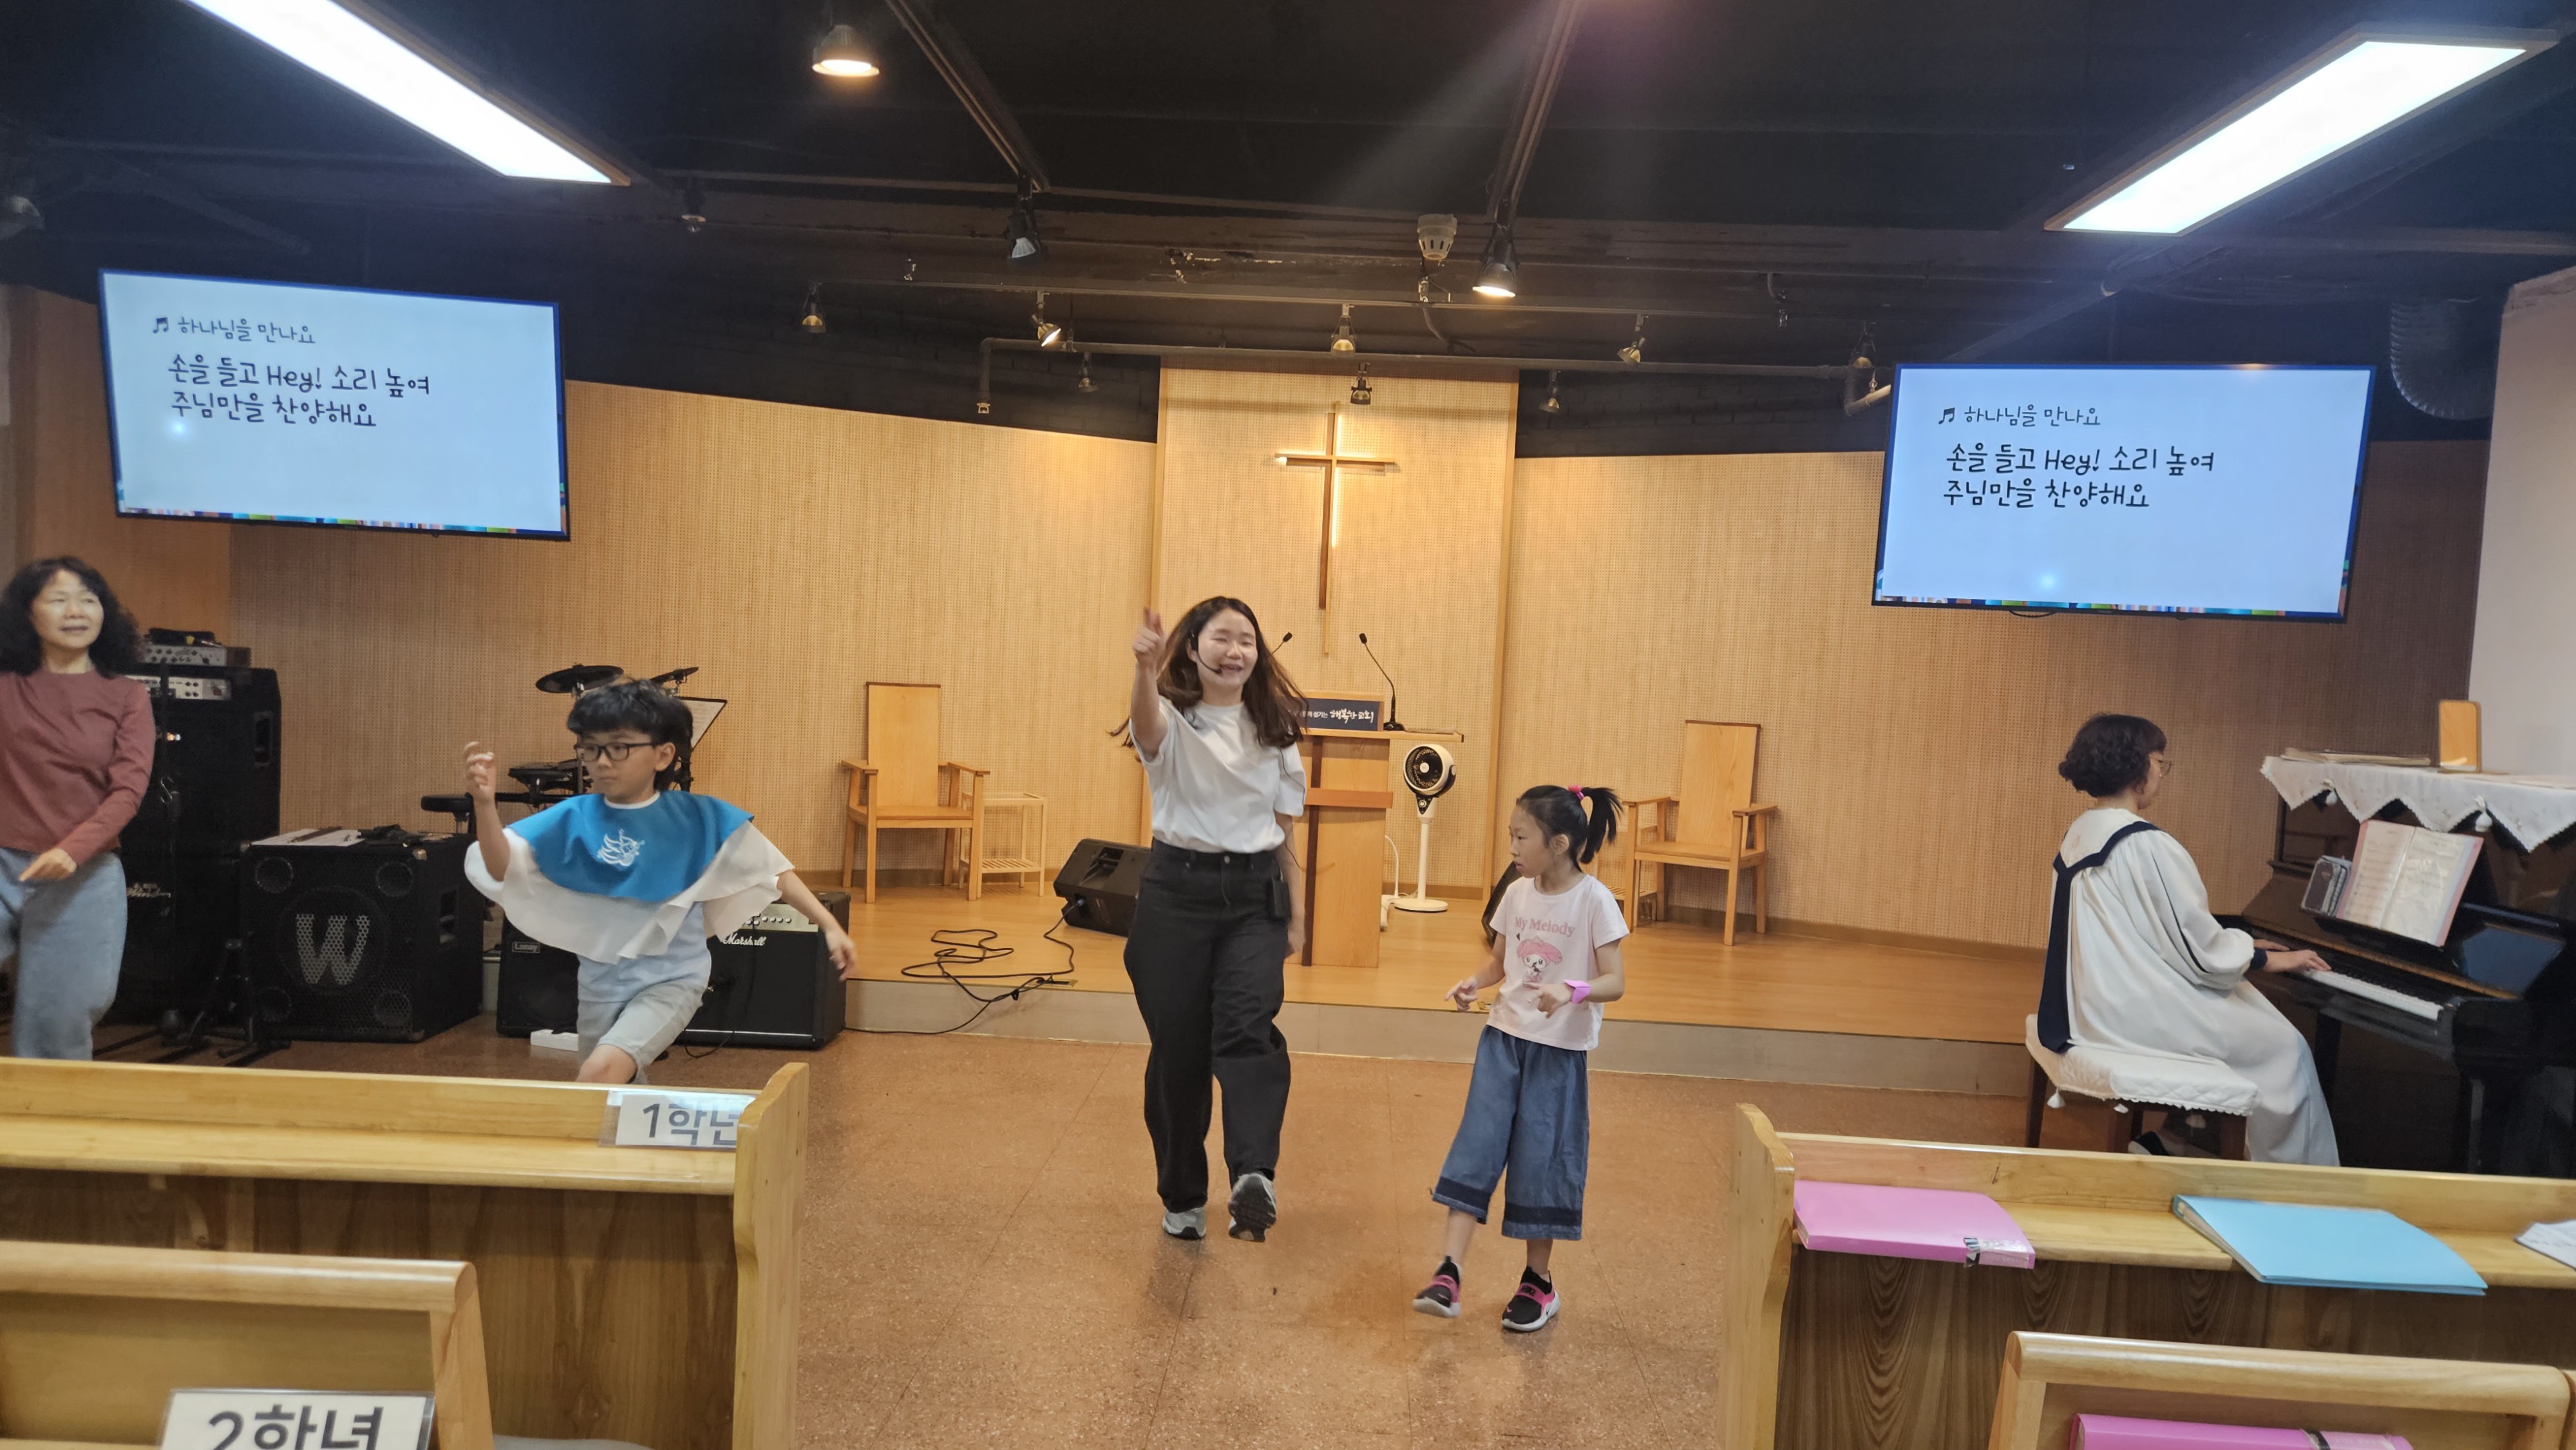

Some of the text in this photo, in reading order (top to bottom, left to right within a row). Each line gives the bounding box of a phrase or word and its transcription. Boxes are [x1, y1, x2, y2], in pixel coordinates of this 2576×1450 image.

[177, 316, 316, 344] 하나님을 만나요
[168, 353, 430, 399] 손을 들고 Hey! 소리 높여
[171, 391, 377, 427] 주님만을 찬양해요
[1964, 404, 2101, 428] 하나님을 만나요
[1946, 442, 2215, 476] 손을 들고 Hey! 소리 높여
[1943, 478, 2150, 509] 주님만을 찬양해요
[1329, 708, 1358, 724] 행복한
[1358, 710, 1374, 723] 교회
[1515, 916, 1576, 937] My Melody
[296, 914, 370, 984] W
